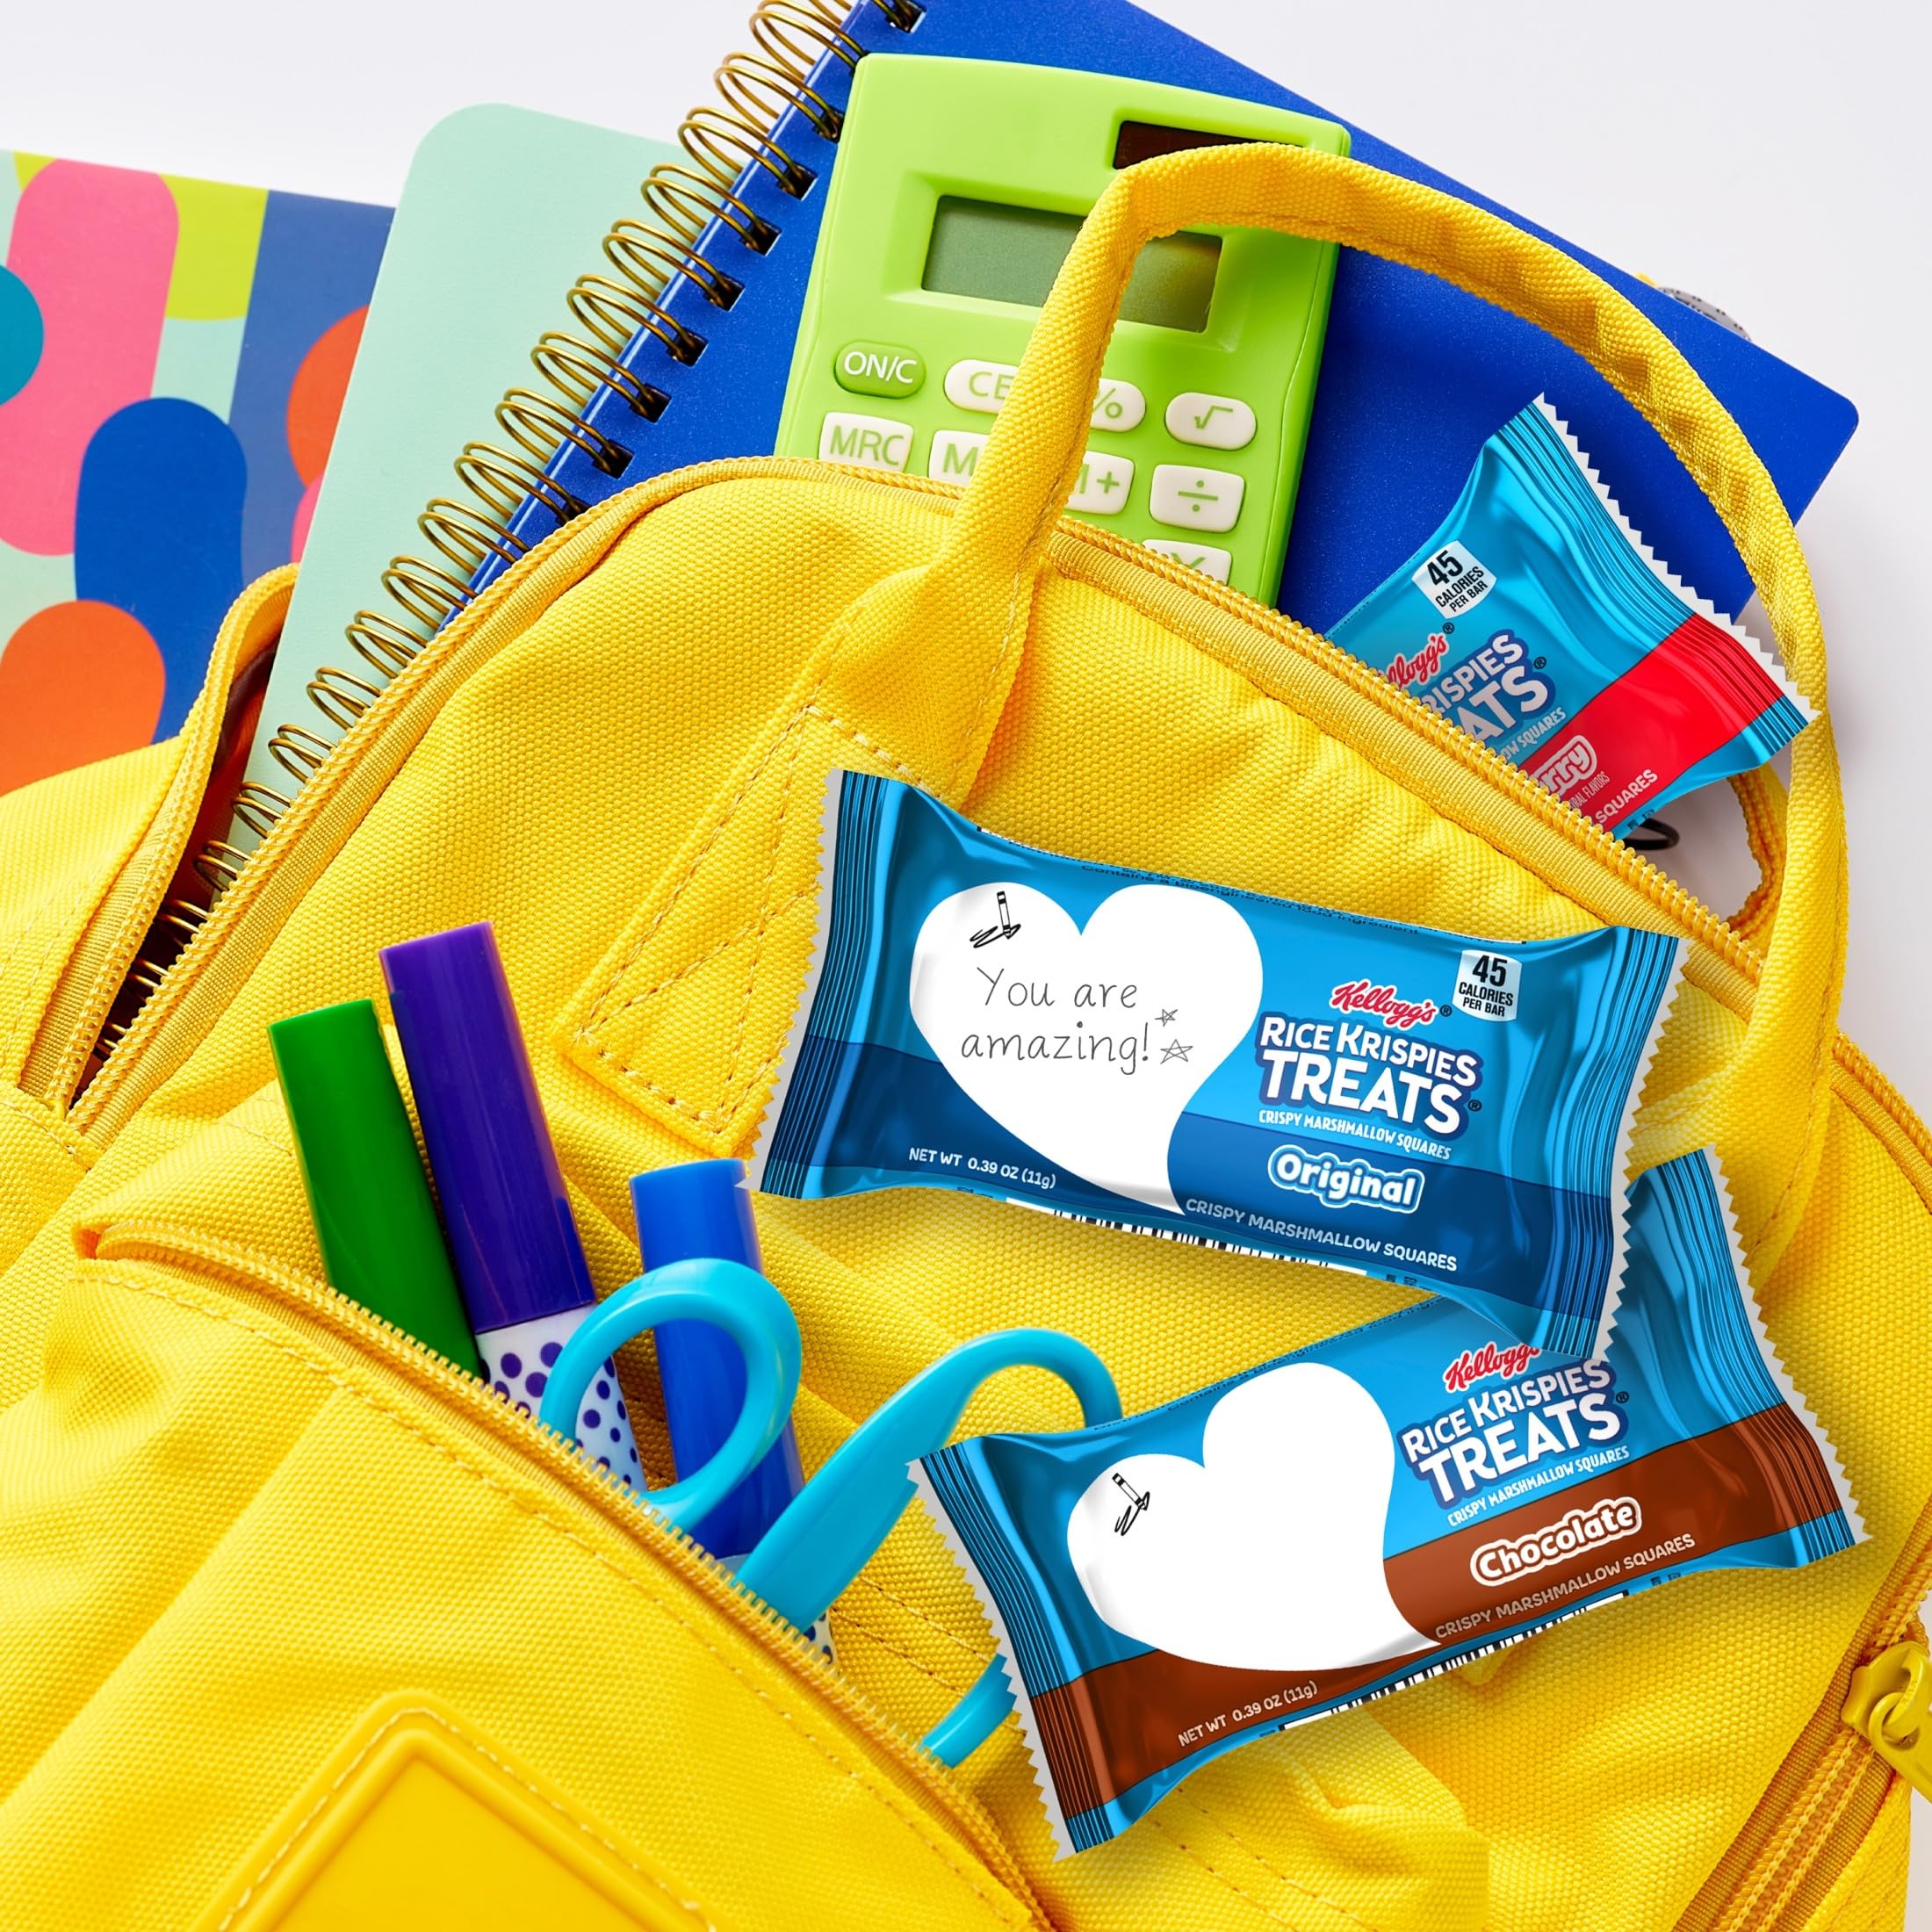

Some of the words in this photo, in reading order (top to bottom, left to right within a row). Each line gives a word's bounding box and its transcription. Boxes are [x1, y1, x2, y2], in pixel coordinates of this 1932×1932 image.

[844, 351, 916, 383] ON/C
[829, 425, 905, 465] MRC
[1427, 550, 1463, 586] 45
[1435, 566, 1484, 607] CALORIES
[1449, 595, 1469, 612] PER
[1467, 580, 1489, 598] BAR
[1422, 634, 1523, 713] RISPIES
[1457, 666, 1548, 741] ATS
[1517, 707, 1567, 748] SQUARES
[1539, 741, 1591, 793] rry
[1582, 771, 1611, 799] FLAVORS
[1595, 768, 1658, 824] SQUARES
[977, 966, 1056, 1006] You
[1074, 984, 1137, 1009] are
[1458, 981, 1514, 1006] CALORIES
[1472, 955, 1508, 987] 45
[1331, 981, 1437, 1027] Kellogg's
[1462, 997, 1482, 1011] PER
[1484, 1002, 1506, 1017] BAR
[962, 1020, 1149, 1075] amazing!
[1259, 1016, 1334, 1049] RICE
[1336, 1021, 1478, 1086] KRISPIES
[1262, 1049, 1462, 1134] TREATS
[1258, 1109, 1303, 1128] CRISPY
[1304, 1116, 1397, 1143] MARSHMALLOW
[1396, 1134, 1452, 1159] SQUARES
[908, 1147, 937, 1163] NET
[940, 1151, 962, 1166] WT
[967, 1157, 998, 1174] 0.39
[999, 1164, 1019, 1179] OZ
[1020, 1167, 1056, 1190] (11g)
[1276, 1152, 1417, 1206] Original
[1186, 1198, 1246, 1222] CRISPY
[1248, 1215, 1382, 1253] MARSHMALLOW
[1382, 1244, 1458, 1272] SQUARES
[1445, 1344, 1540, 1390] Kellogg
[1402, 1408, 1473, 1463] RICE
[1468, 1359, 1611, 1428] KRISPIES
[1418, 1392, 1621, 1503] TREATS
[1447, 1498, 1487, 1527] CRISPY
[1489, 1462, 1575, 1507] MARSHMALLOW
[1575, 1445, 1630, 1473] SQUARES
[1478, 1501, 1634, 1578] Chocolate
[1434, 1608, 1492, 1640] CRISPY
[1496, 1561, 1622, 1619] MARSHMALLOW
[1623, 1532, 1696, 1571] SQUARES
[1178, 1724, 1204, 1748] NET
[1205, 1714, 1227, 1733] WT
[1231, 1701, 1262, 1722] 0.39
[1263, 1693, 1282, 1710] OZ
[1283, 1679, 1318, 1705] (11g)
